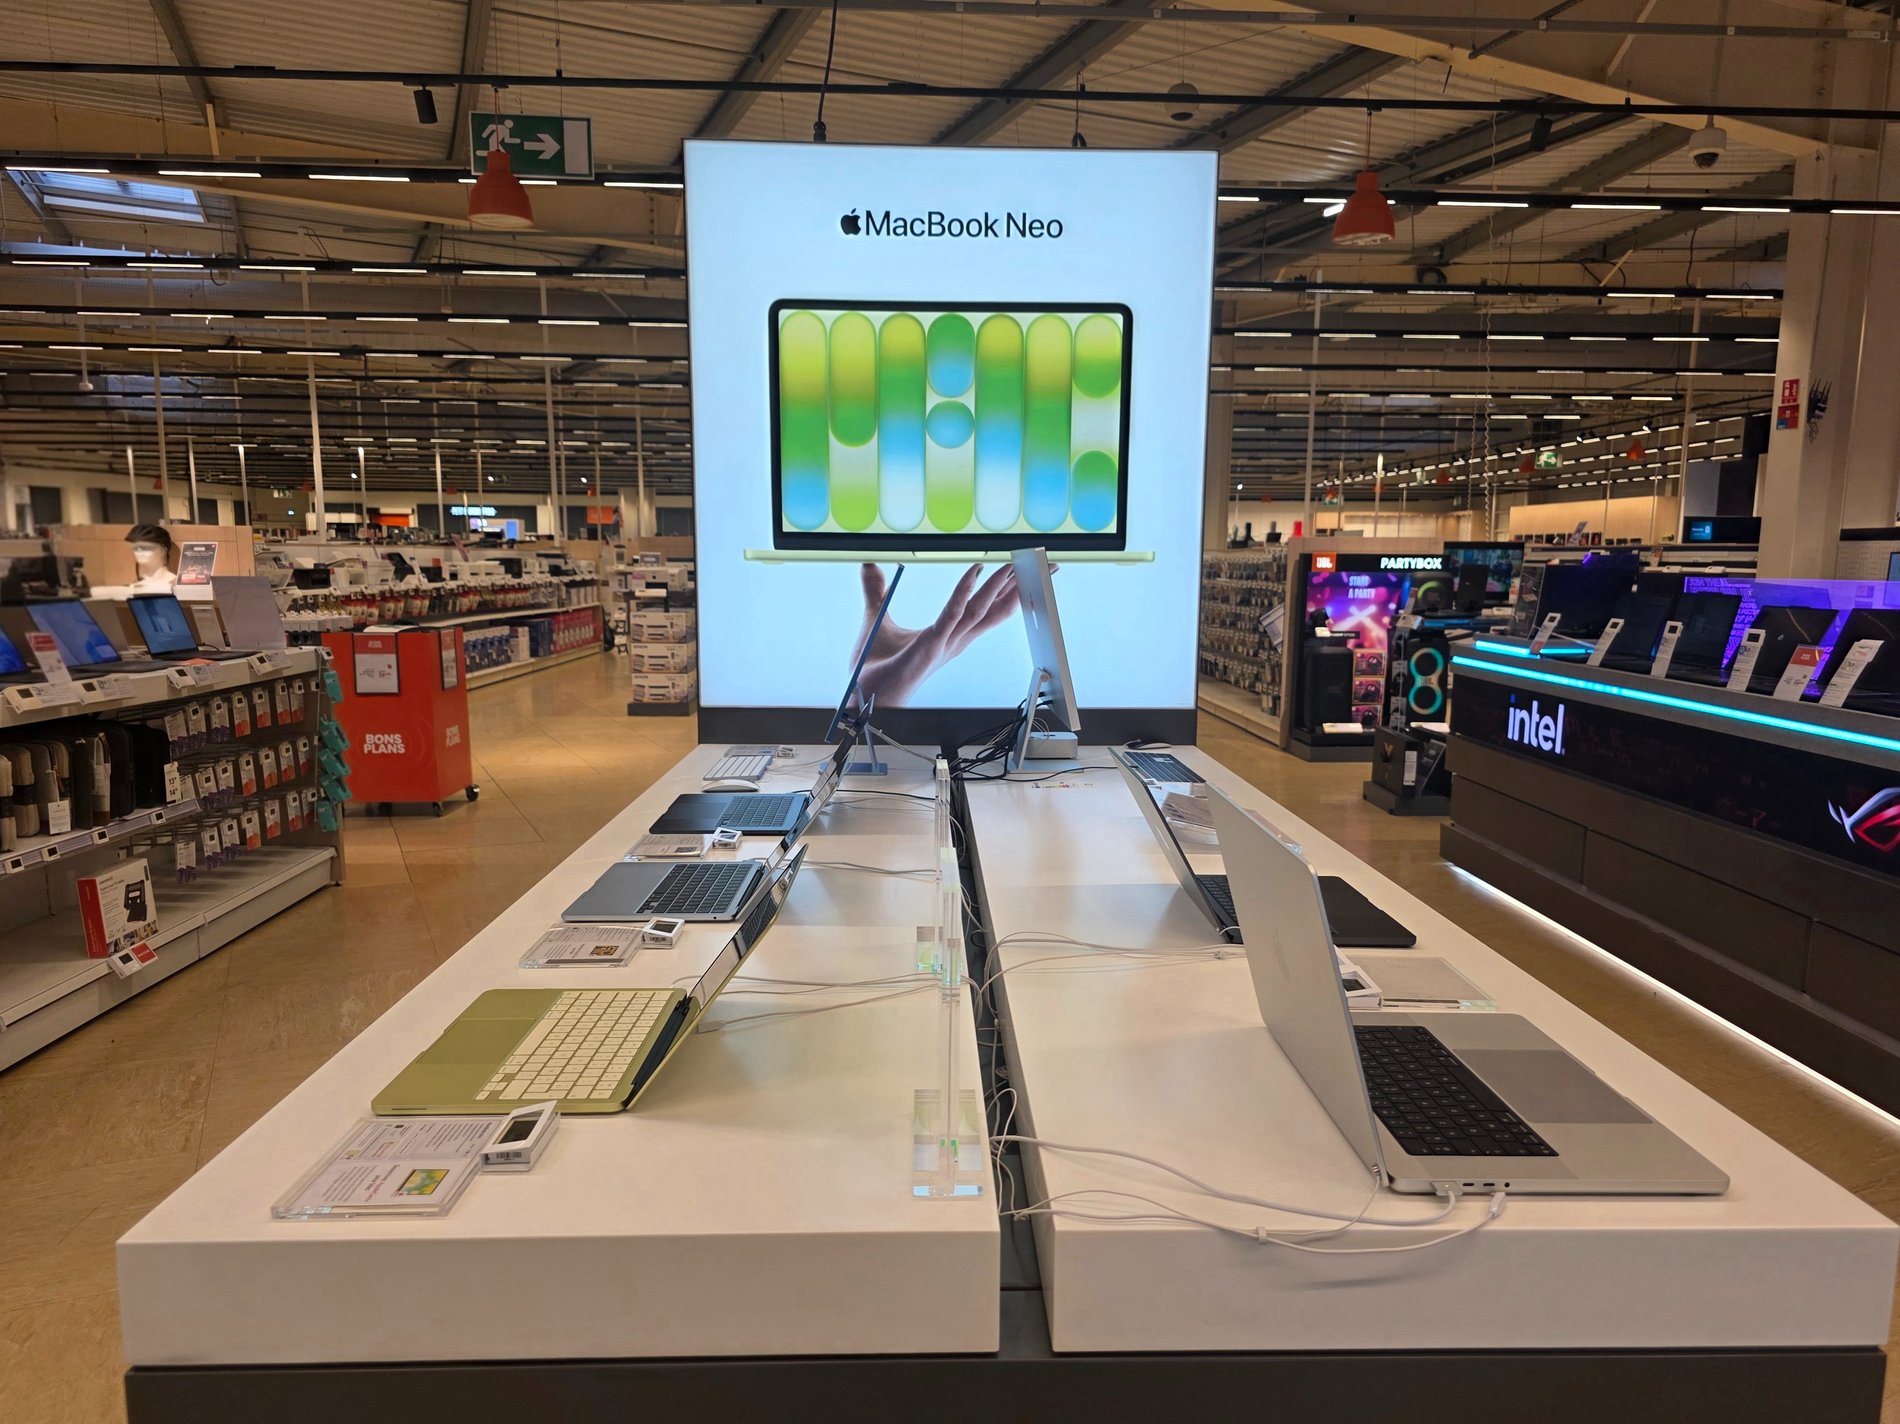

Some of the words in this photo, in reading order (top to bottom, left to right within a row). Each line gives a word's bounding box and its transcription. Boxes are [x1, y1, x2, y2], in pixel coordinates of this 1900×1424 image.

[865, 210, 999, 238] MacBook
[1006, 212, 1063, 240] Neo
[1381, 557, 1442, 569] PARTYBOX
[1354, 588, 1376, 598] PARTY
[365, 734, 402, 744] BONS
[363, 744, 405, 754] PLANS
